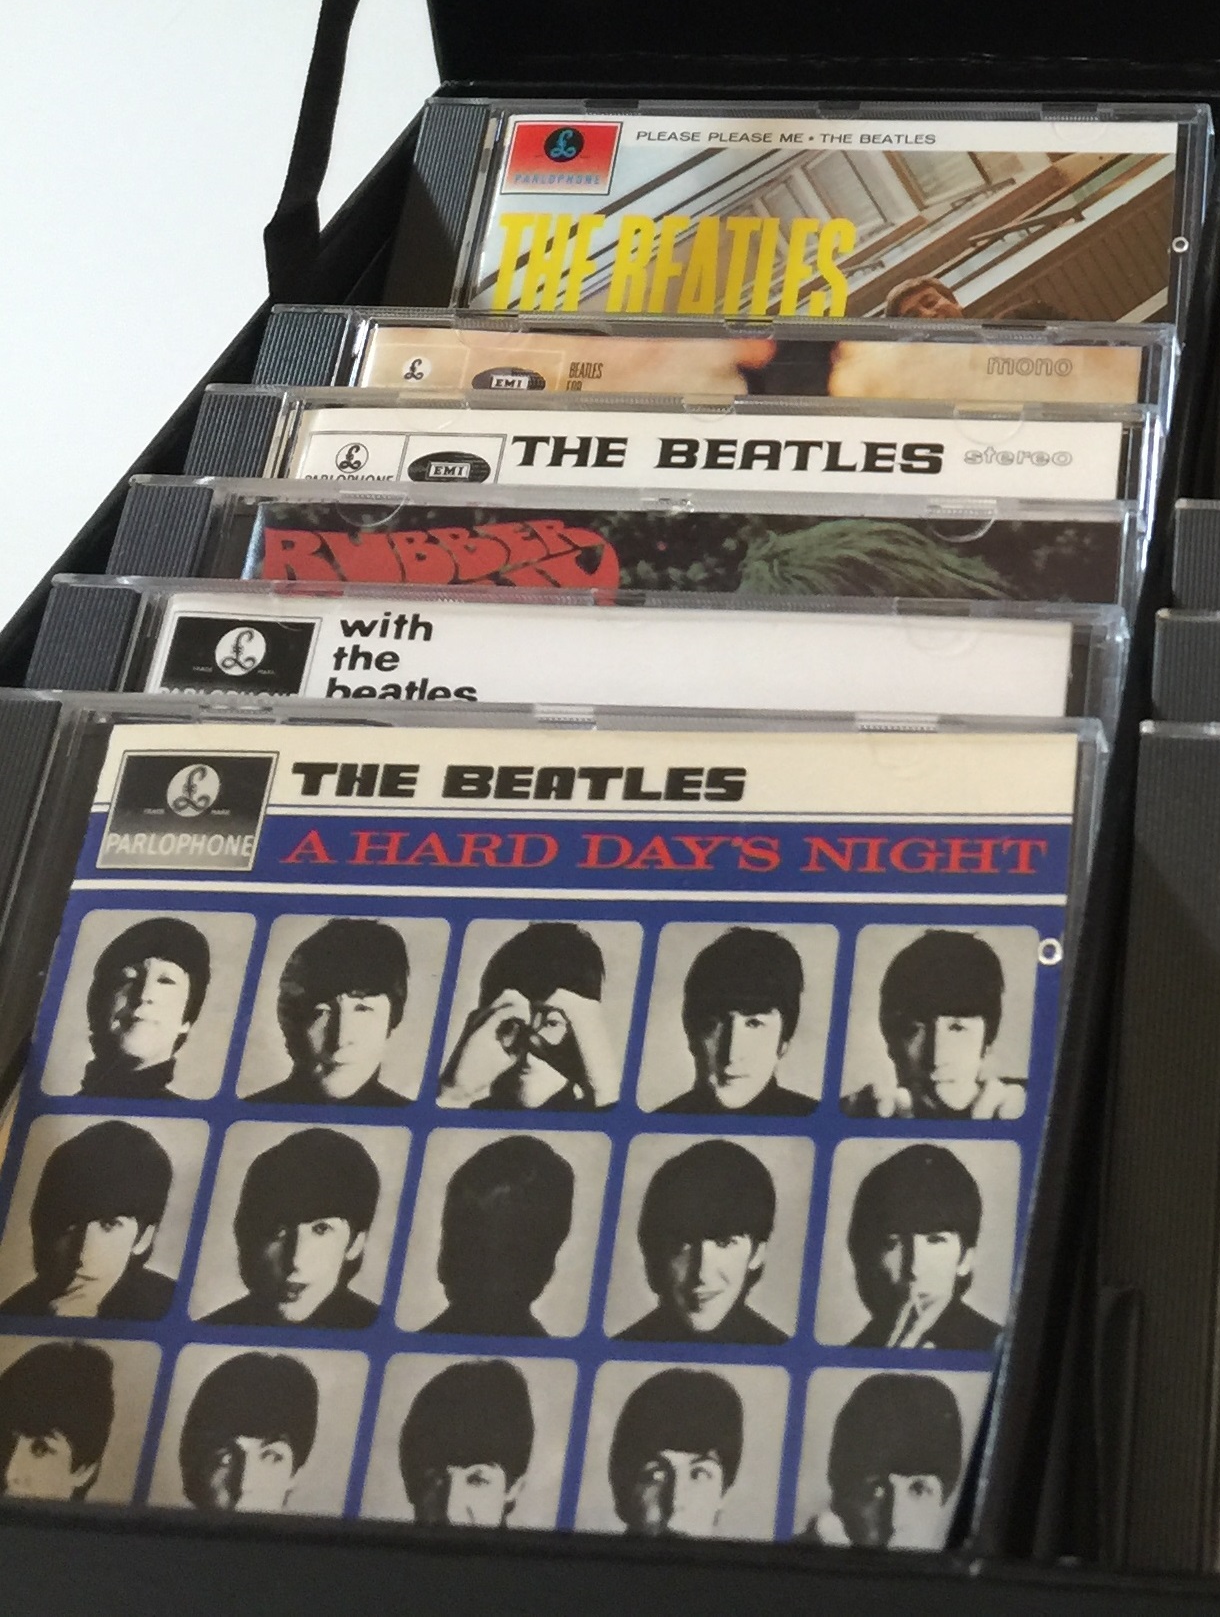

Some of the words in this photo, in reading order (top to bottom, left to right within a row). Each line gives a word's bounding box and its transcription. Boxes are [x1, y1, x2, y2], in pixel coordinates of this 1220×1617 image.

[635, 130, 700, 143] PLEASE
[708, 131, 772, 144] PLEASE
[779, 132, 804, 144] ME
[819, 133, 852, 145] THE
[859, 133, 937, 146] BEATLES
[568, 361, 604, 379] BEATLES
[987, 356, 1073, 377] mono
[495, 378, 523, 387] EMI
[511, 435, 628, 468] THE
[655, 438, 944, 475] BEATLES
[963, 446, 1073, 466] stereo
[433, 465, 464, 476] EMI
[264, 519, 578, 586] RUBBER
[340, 611, 433, 642] with
[333, 644, 400, 672] the
[325, 677, 478, 702] beatles
[291, 761, 418, 800] THE
[441, 762, 747, 803] BEATLES
[104, 832, 255, 858] PARLOPHONE
[284, 829, 334, 864] A
[346, 830, 558, 868] HARD
[576, 833, 780, 872] DAY'S
[802, 836, 1049, 875] NIGHT
